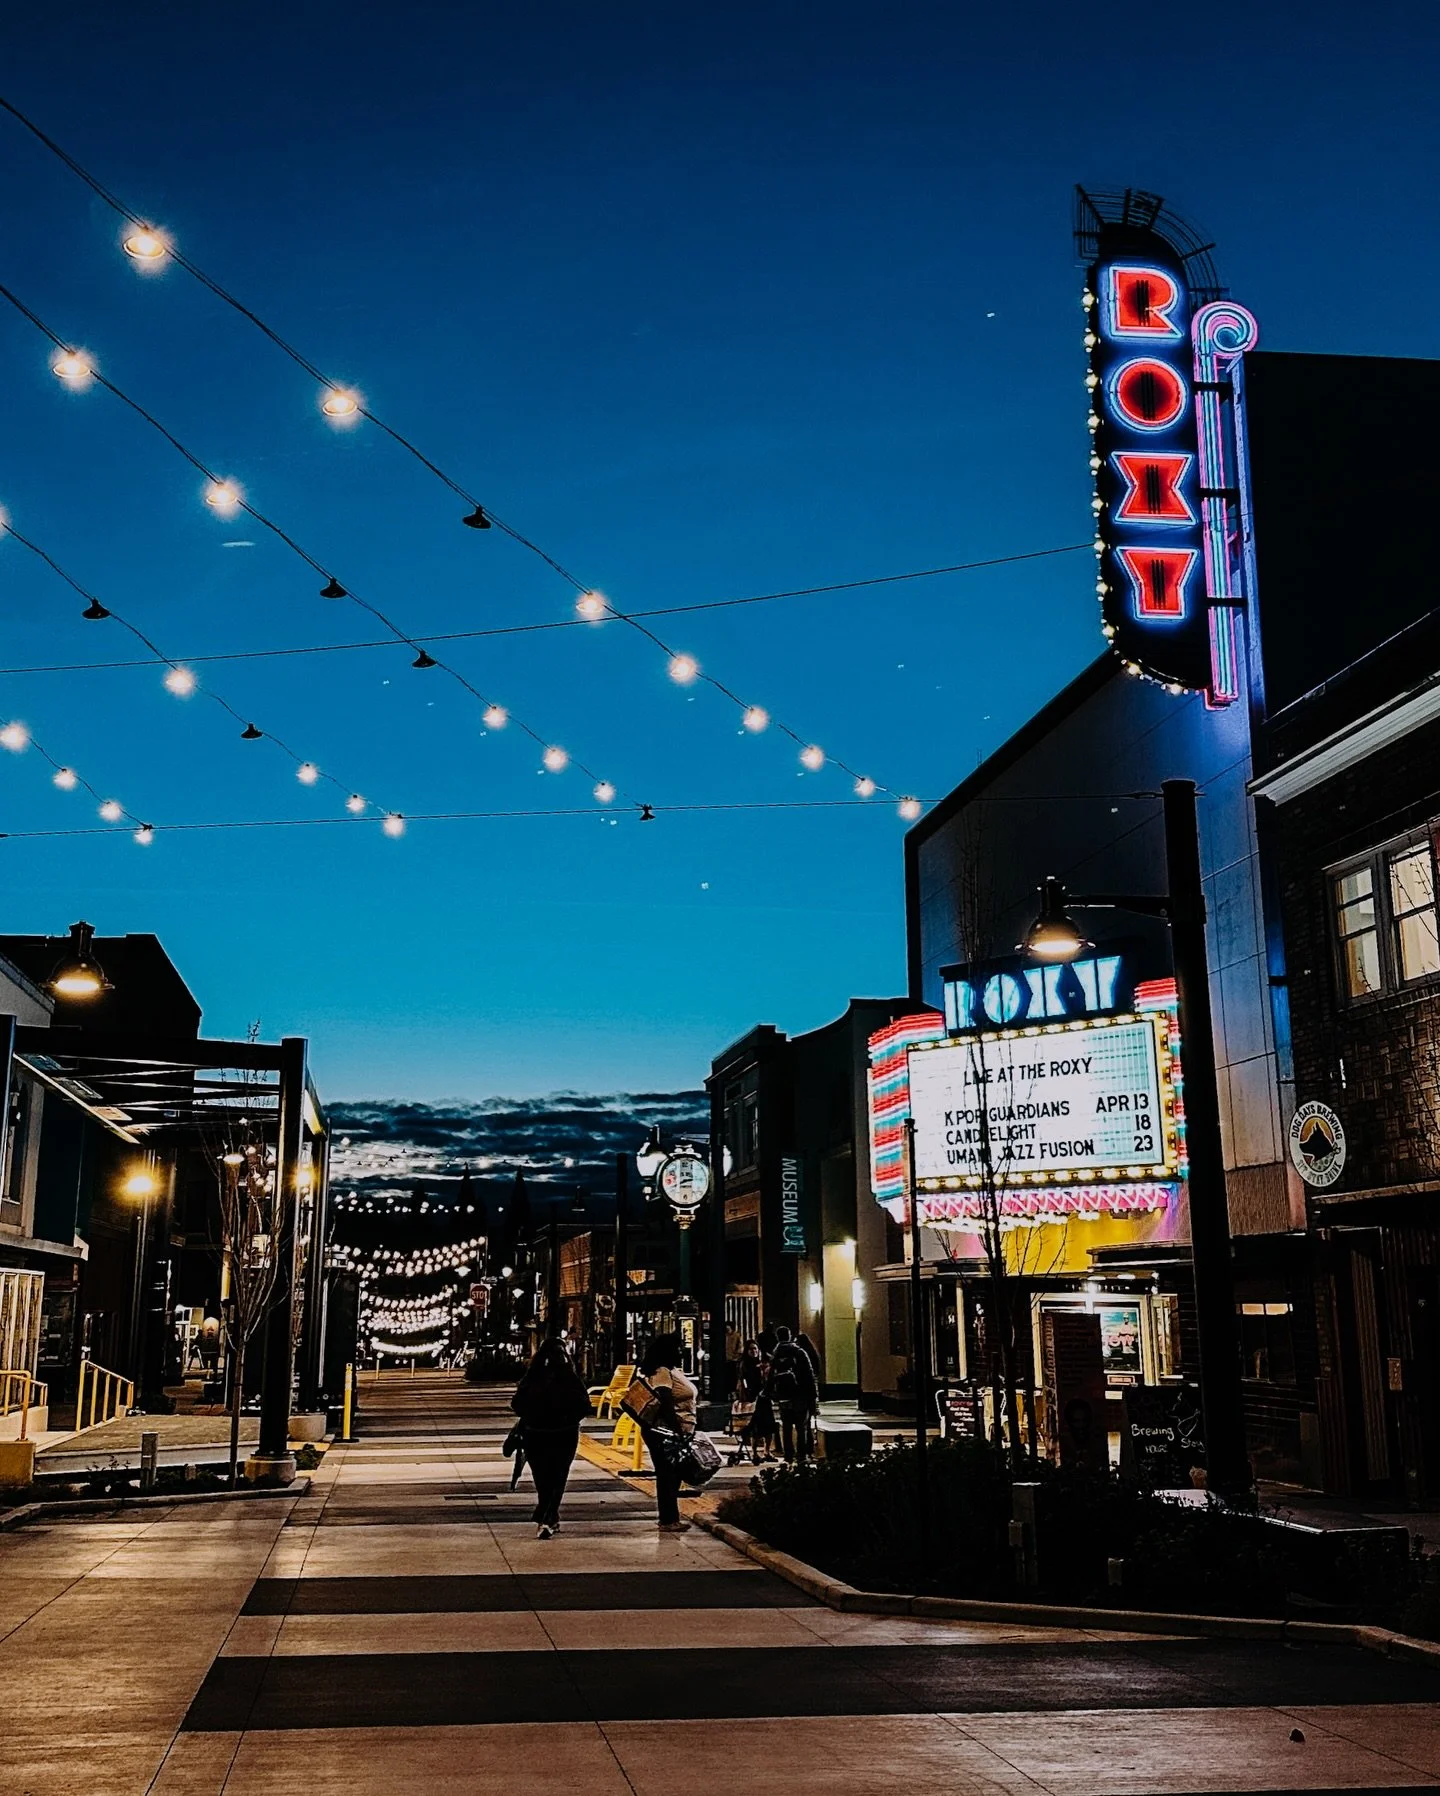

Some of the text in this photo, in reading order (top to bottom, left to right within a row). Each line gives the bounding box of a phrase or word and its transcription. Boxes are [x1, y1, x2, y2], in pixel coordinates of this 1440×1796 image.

[1108, 265, 1198, 621] ROXY
[944, 955, 1121, 1028] ROXY
[964, 1056, 1093, 1086] LIVE AT THE ROXY
[989, 1100, 1070, 1122] GUARDIANS
[1096, 1095, 1130, 1113] APR
[1133, 1093, 1149, 1110] 13
[1292, 1104, 1343, 1140] DOG DAYS BREWING
[946, 1114, 1151, 1145] CANDELIGHT 18
[998, 1143, 1035, 1161] JAZZ
[1040, 1138, 1095, 1159] FUSION
[1133, 1135, 1153, 1152] 23
[782, 1158, 799, 1224] MUSEUM
[1131, 1423, 1175, 1441] Brewing
